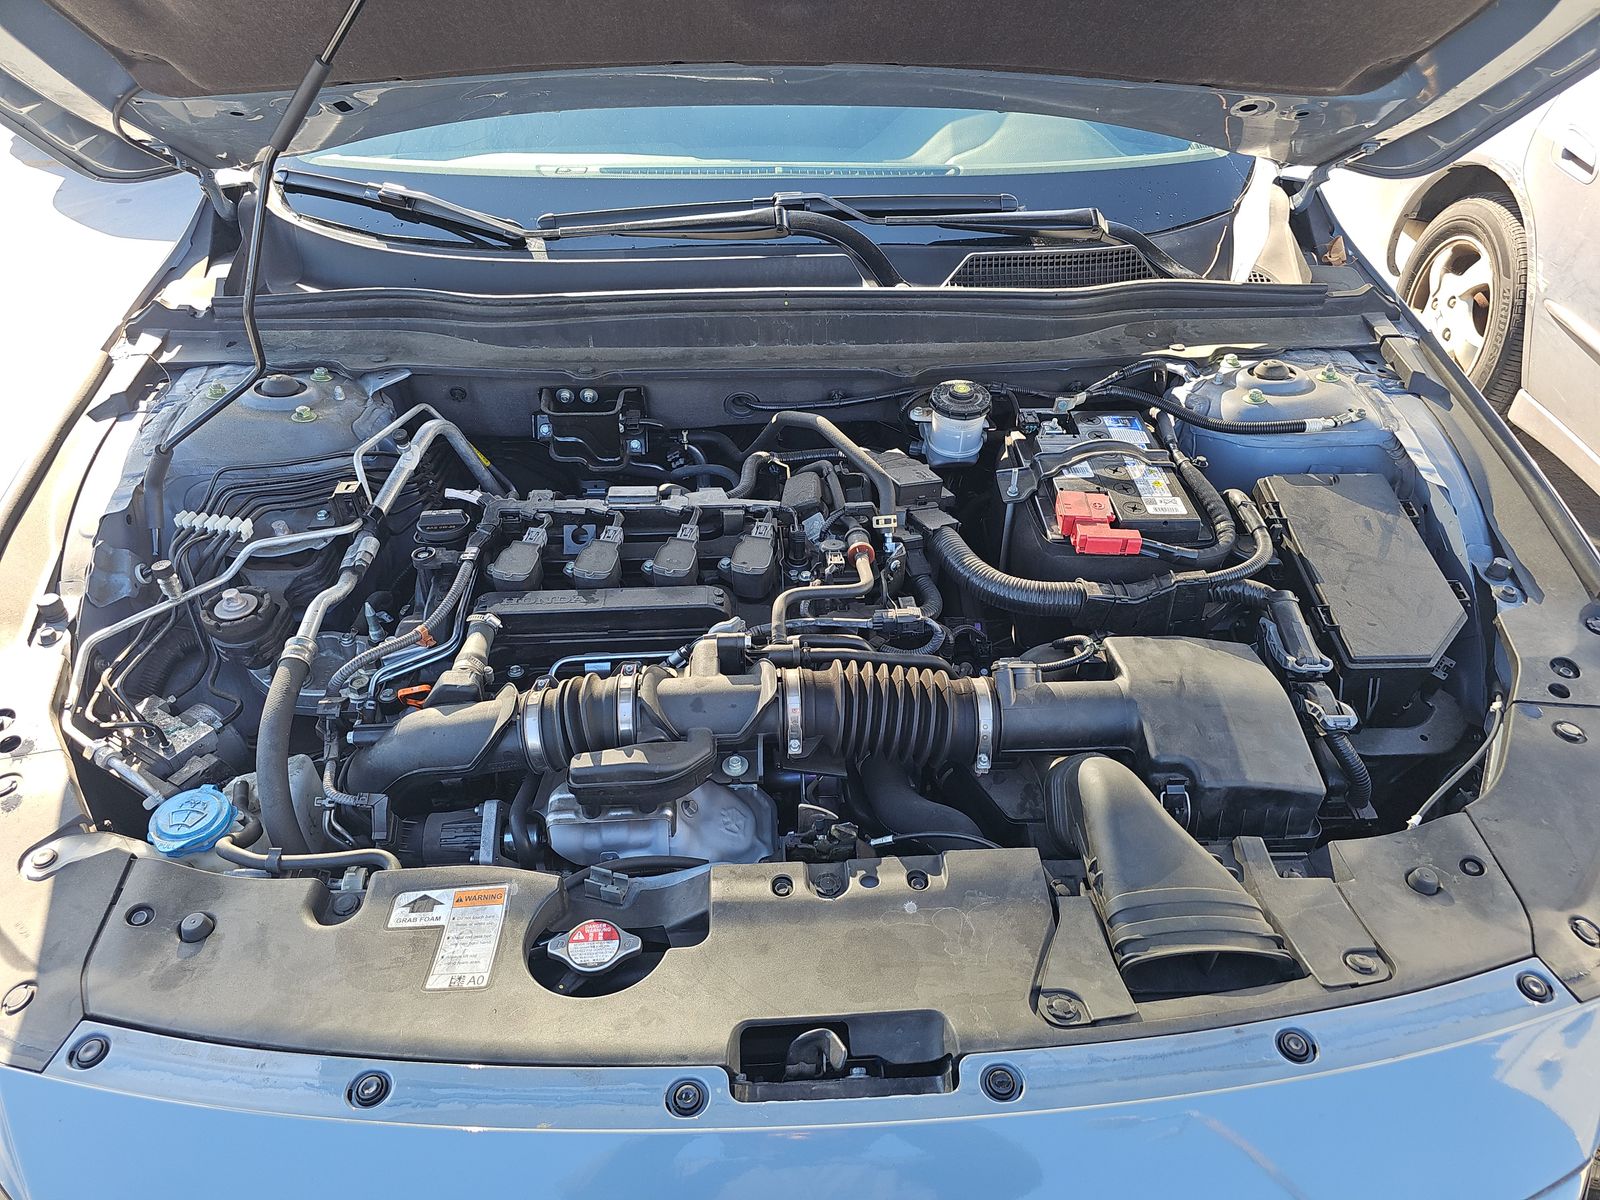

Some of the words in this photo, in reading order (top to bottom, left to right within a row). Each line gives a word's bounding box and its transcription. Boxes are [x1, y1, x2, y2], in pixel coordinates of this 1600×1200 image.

[500, 595, 587, 606] HONDA
[464, 893, 503, 902] WARNING
[466, 975, 485, 986] A0
